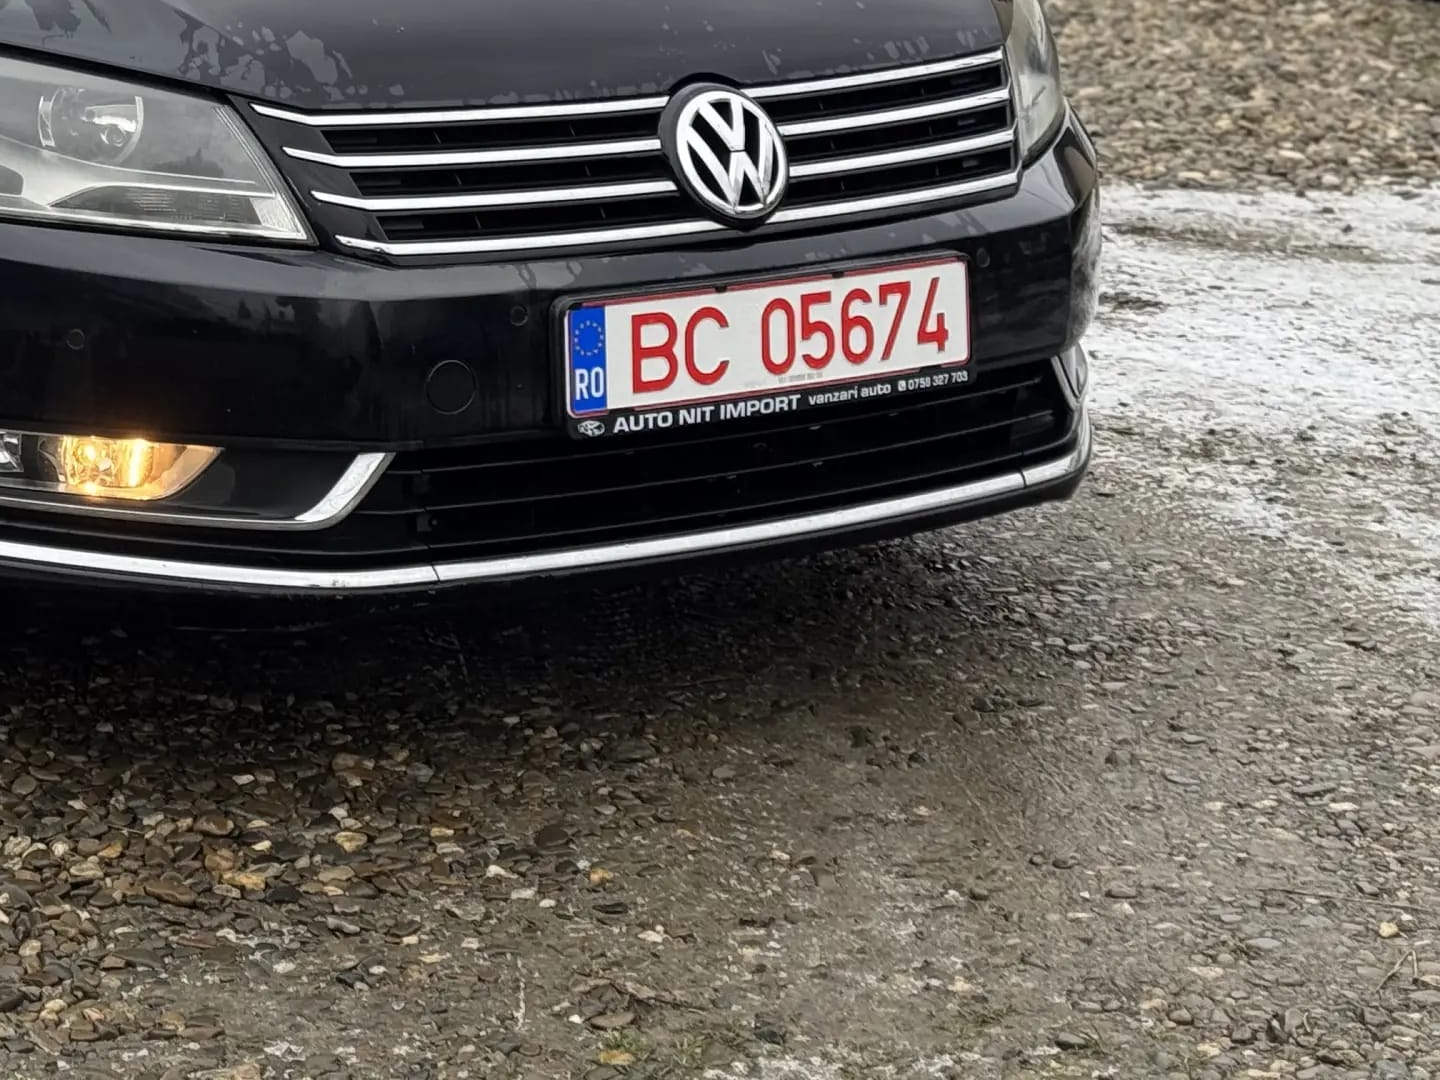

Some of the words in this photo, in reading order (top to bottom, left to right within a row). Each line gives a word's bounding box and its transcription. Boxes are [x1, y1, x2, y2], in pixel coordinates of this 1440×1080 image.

[676, 90, 788, 218] VW
[631, 306, 730, 395] BC
[760, 276, 950, 376] 05674
[574, 367, 605, 401] RO
[613, 411, 674, 434] AUTO
[678, 406, 715, 426] NIT
[719, 394, 802, 421] IMPORT
[808, 385, 859, 406] vanzari
[860, 383, 892, 399] auto
